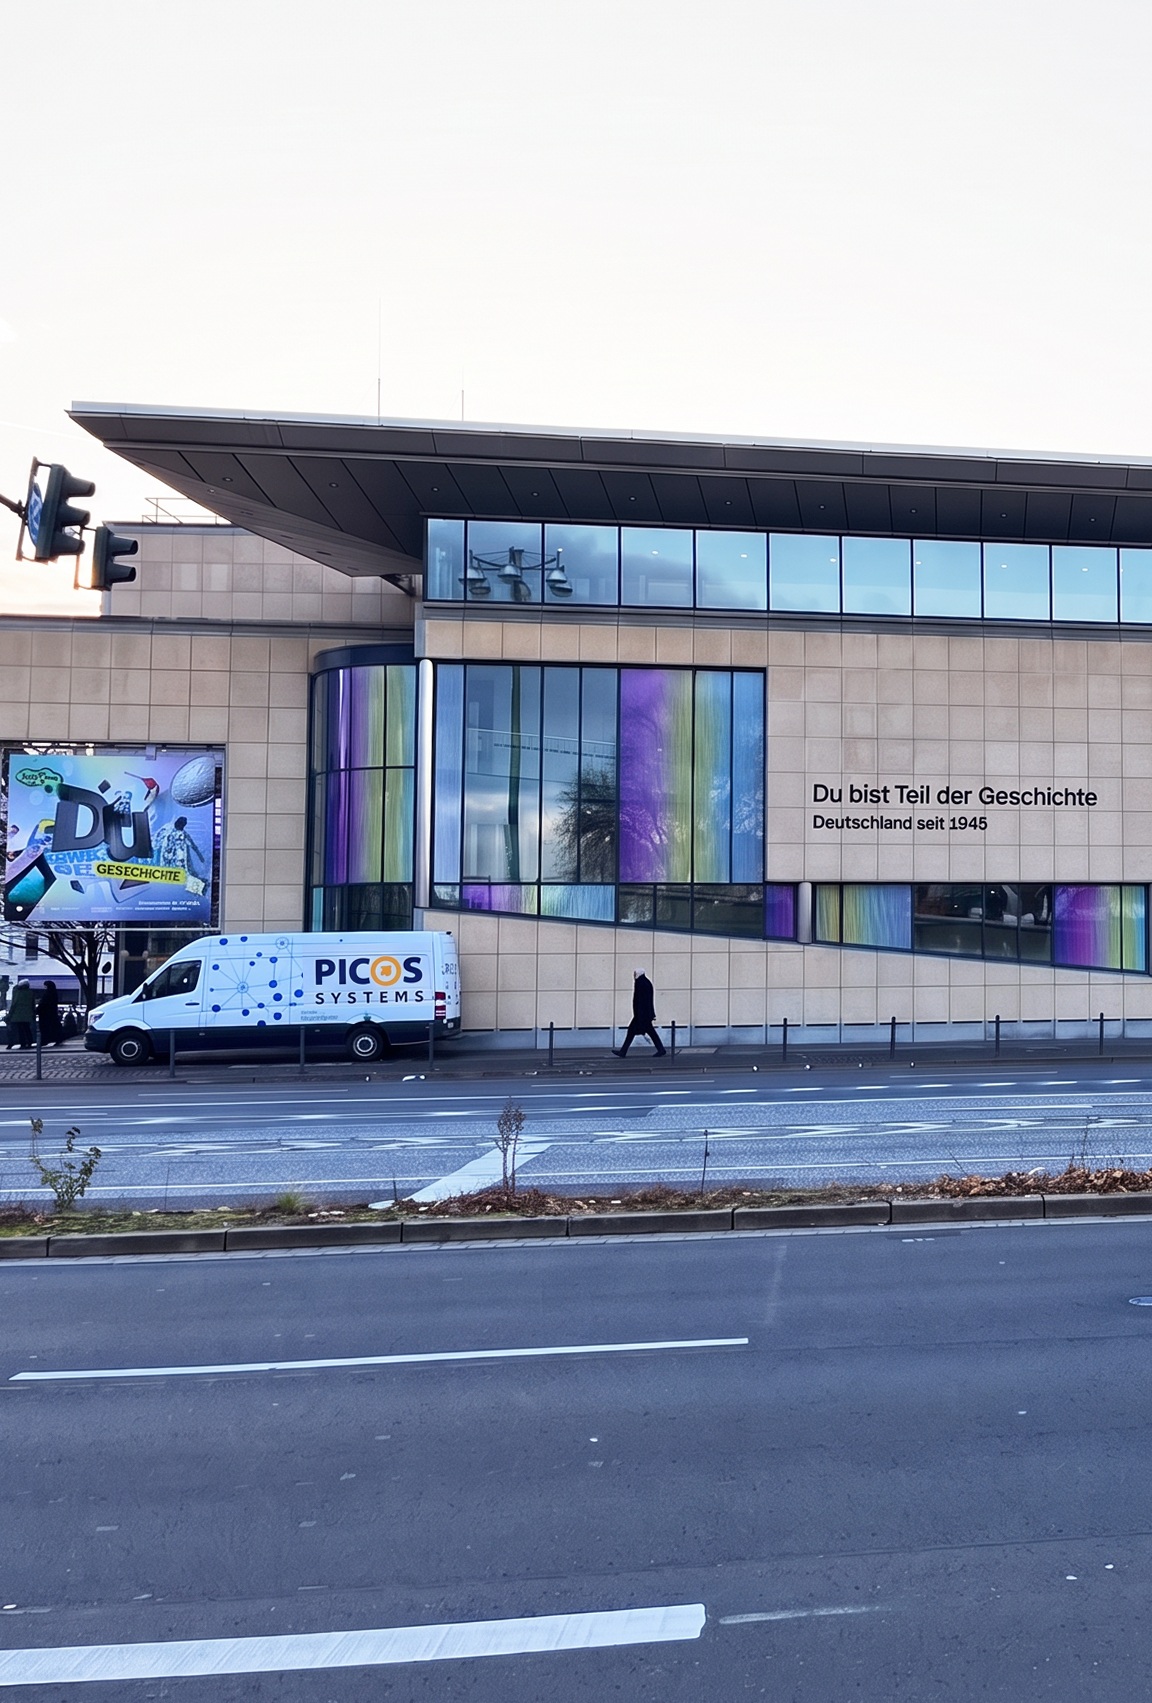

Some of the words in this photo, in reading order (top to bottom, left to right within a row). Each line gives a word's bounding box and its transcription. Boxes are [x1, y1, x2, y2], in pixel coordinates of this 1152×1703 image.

[813, 784, 842, 803] Du
[849, 783, 890, 804] bist
[895, 785, 930, 804] Teil
[937, 786, 973, 805] der
[978, 786, 1098, 806] Geschichte
[51, 783, 154, 862] Du
[813, 815, 912, 830] Deutschland
[917, 816, 945, 830] seit
[949, 816, 988, 830] 1945
[315, 956, 423, 987] PICOS
[315, 990, 424, 1005] SYSTEMS
